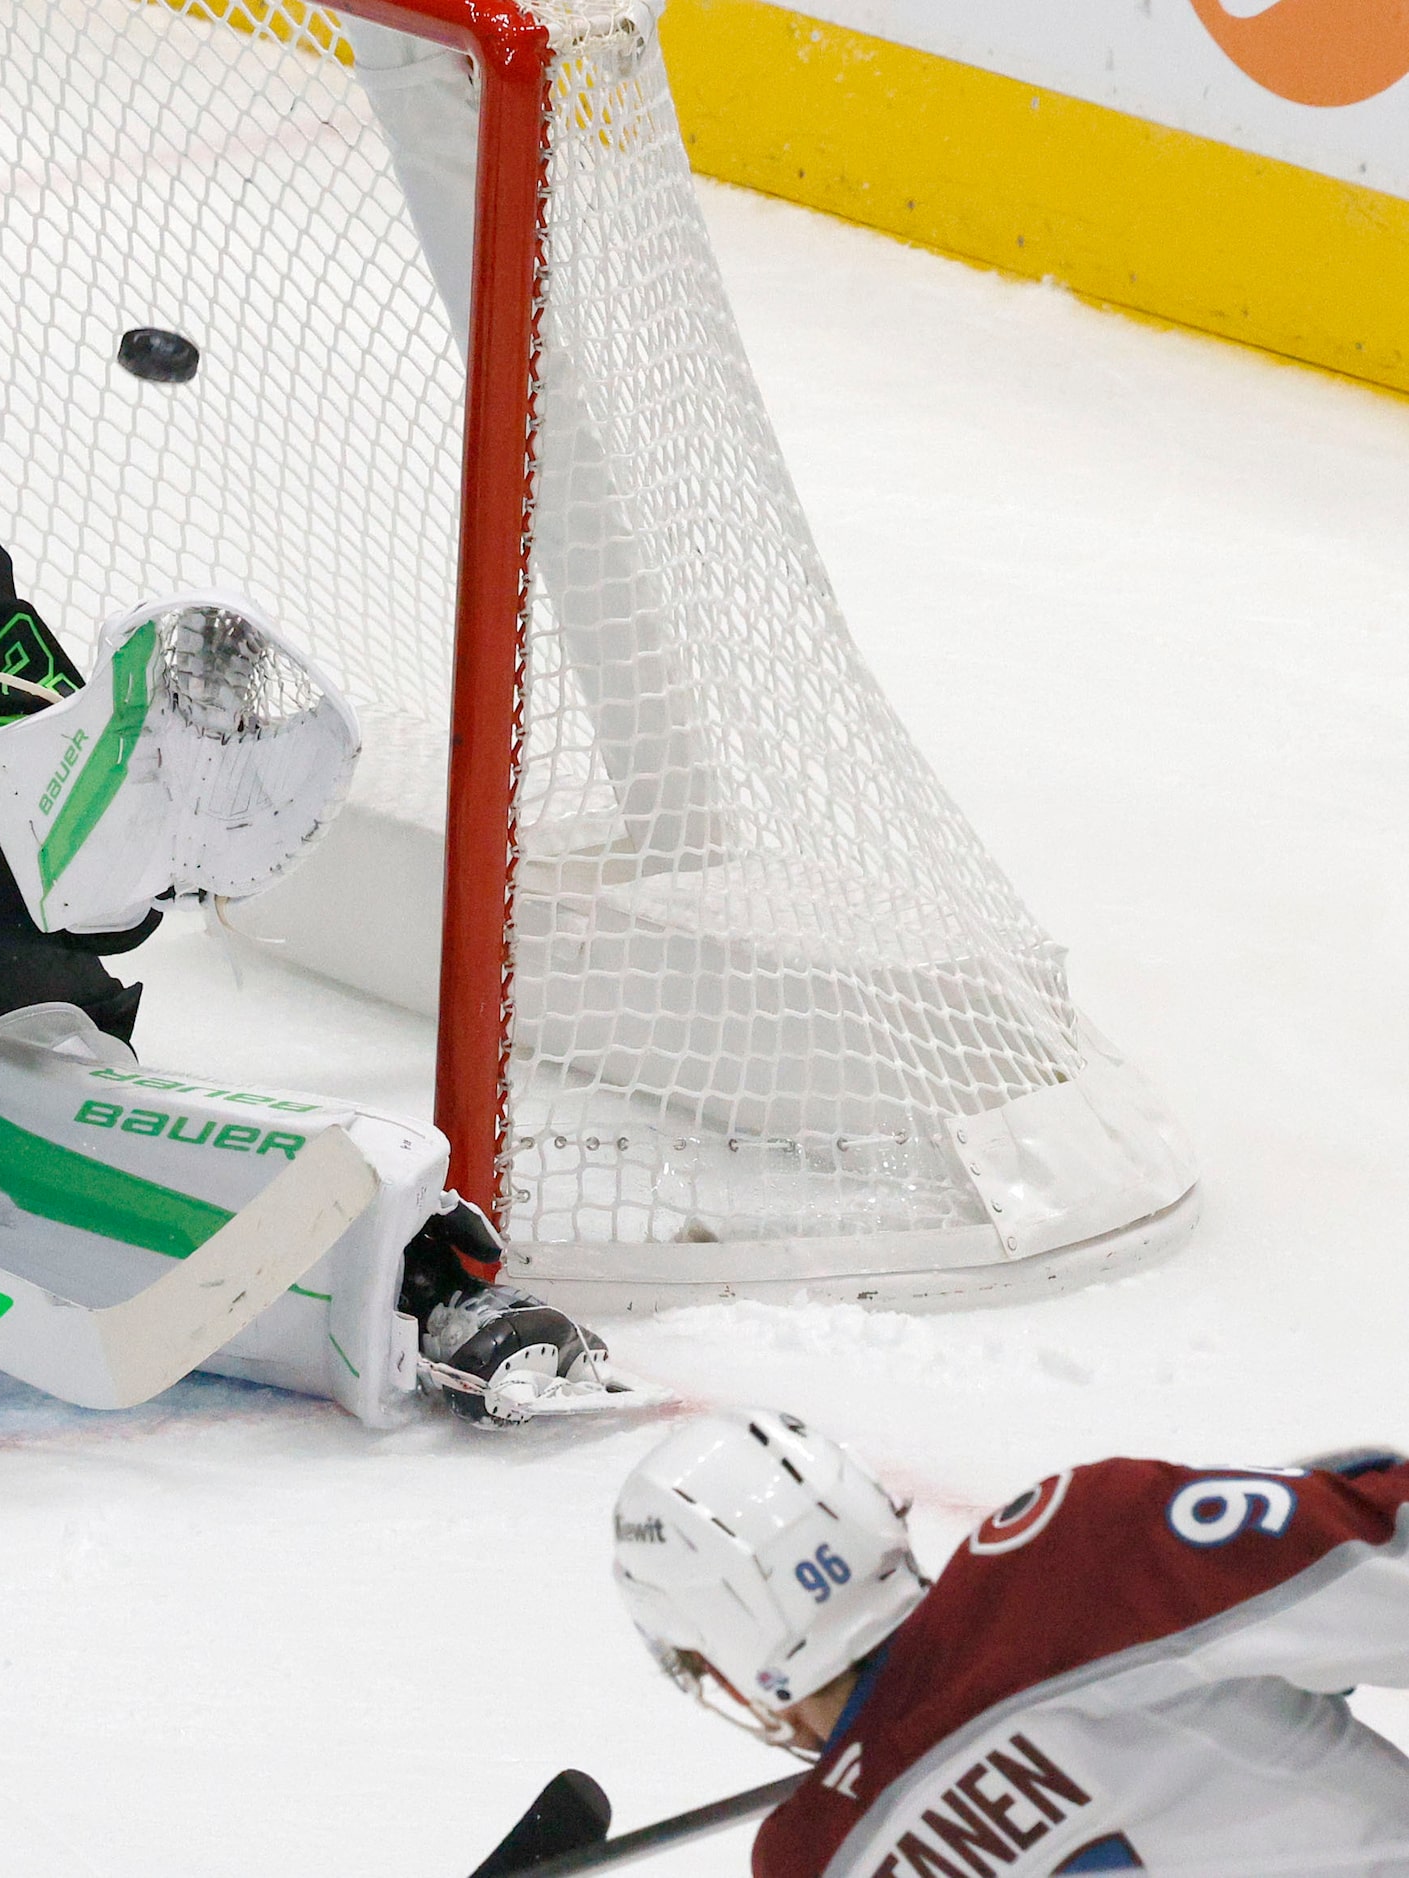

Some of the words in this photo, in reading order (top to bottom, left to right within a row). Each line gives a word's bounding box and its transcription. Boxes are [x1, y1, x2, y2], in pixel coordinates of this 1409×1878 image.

[38, 728, 90, 816] BAUER
[89, 1068, 323, 1113] BAUER
[74, 1100, 306, 1160] BAUER
[795, 1542, 852, 1604] 96
